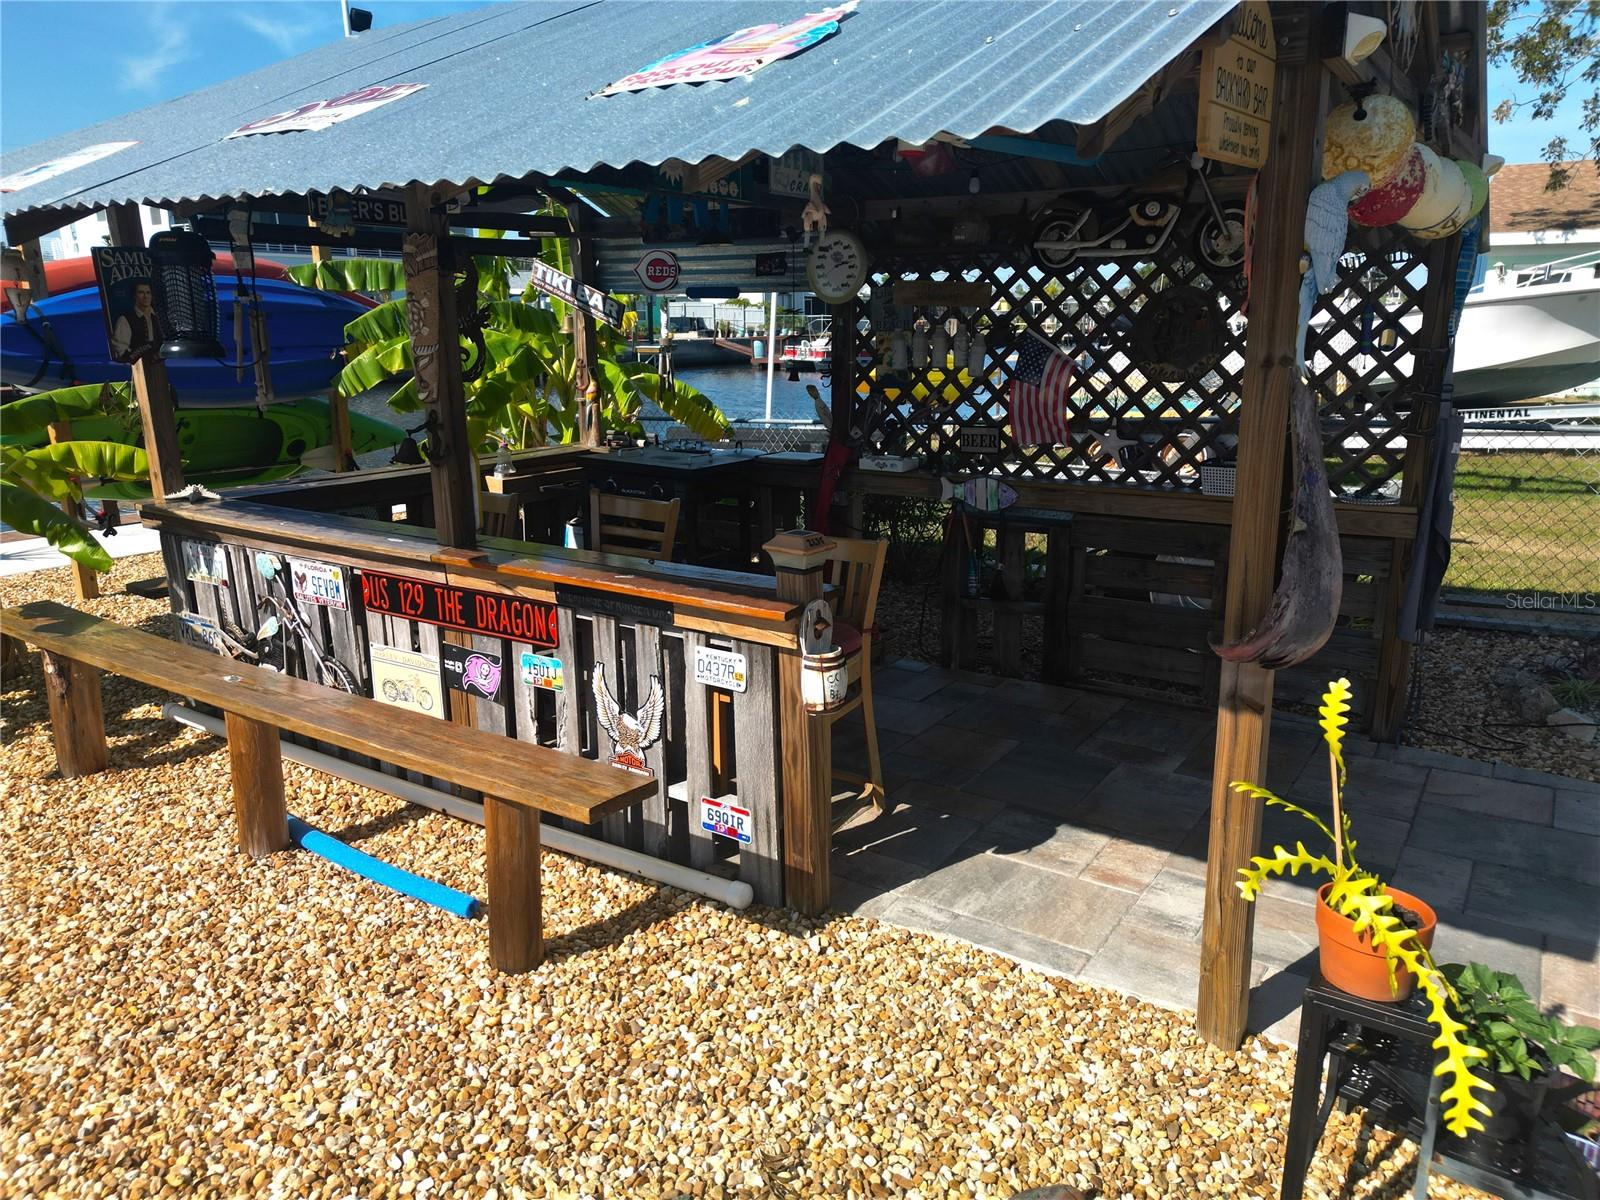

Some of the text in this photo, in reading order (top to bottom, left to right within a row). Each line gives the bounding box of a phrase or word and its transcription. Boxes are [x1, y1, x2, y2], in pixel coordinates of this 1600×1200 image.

[1216, 66, 1268, 116] BACKYARD BAR
[101, 248, 152, 268] SAMU
[647, 265, 676, 277] REDS
[533, 261, 573, 294] TIKI
[576, 284, 619, 319] BAR
[961, 433, 997, 449] BEER
[303, 563, 328, 573] FLORIDA
[369, 575, 390, 610] US
[398, 581, 424, 616] 129
[434, 587, 466, 625] THE
[475, 594, 547, 641] DRAGON
[705, 653, 737, 665] KENTUCKY
[707, 807, 744, 832] 69QIR
